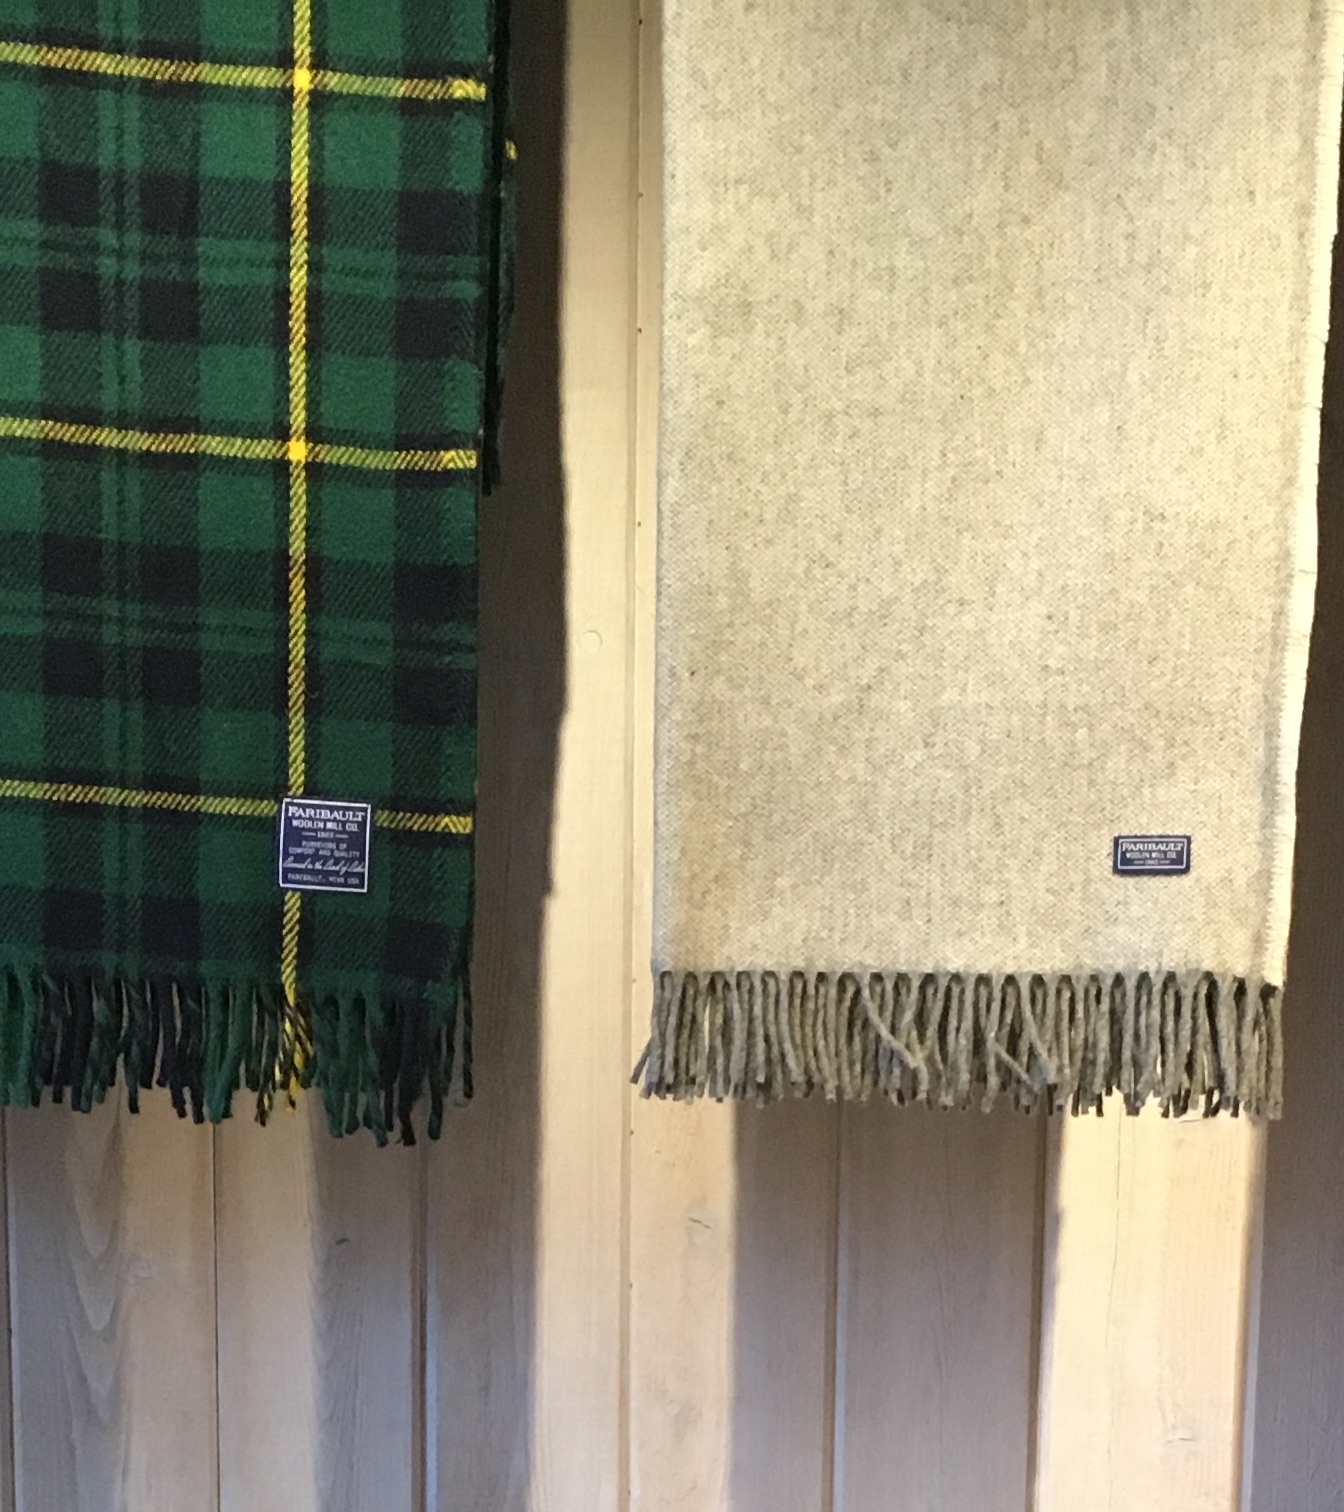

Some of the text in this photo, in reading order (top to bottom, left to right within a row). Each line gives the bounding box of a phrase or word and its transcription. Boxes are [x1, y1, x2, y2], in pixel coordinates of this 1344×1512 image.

[288, 805, 365, 821] FARIBAULT
[291, 818, 324, 829] WOOLEN
[325, 821, 343, 831] MILL
[1122, 842, 1183, 851] FARIBAULT
